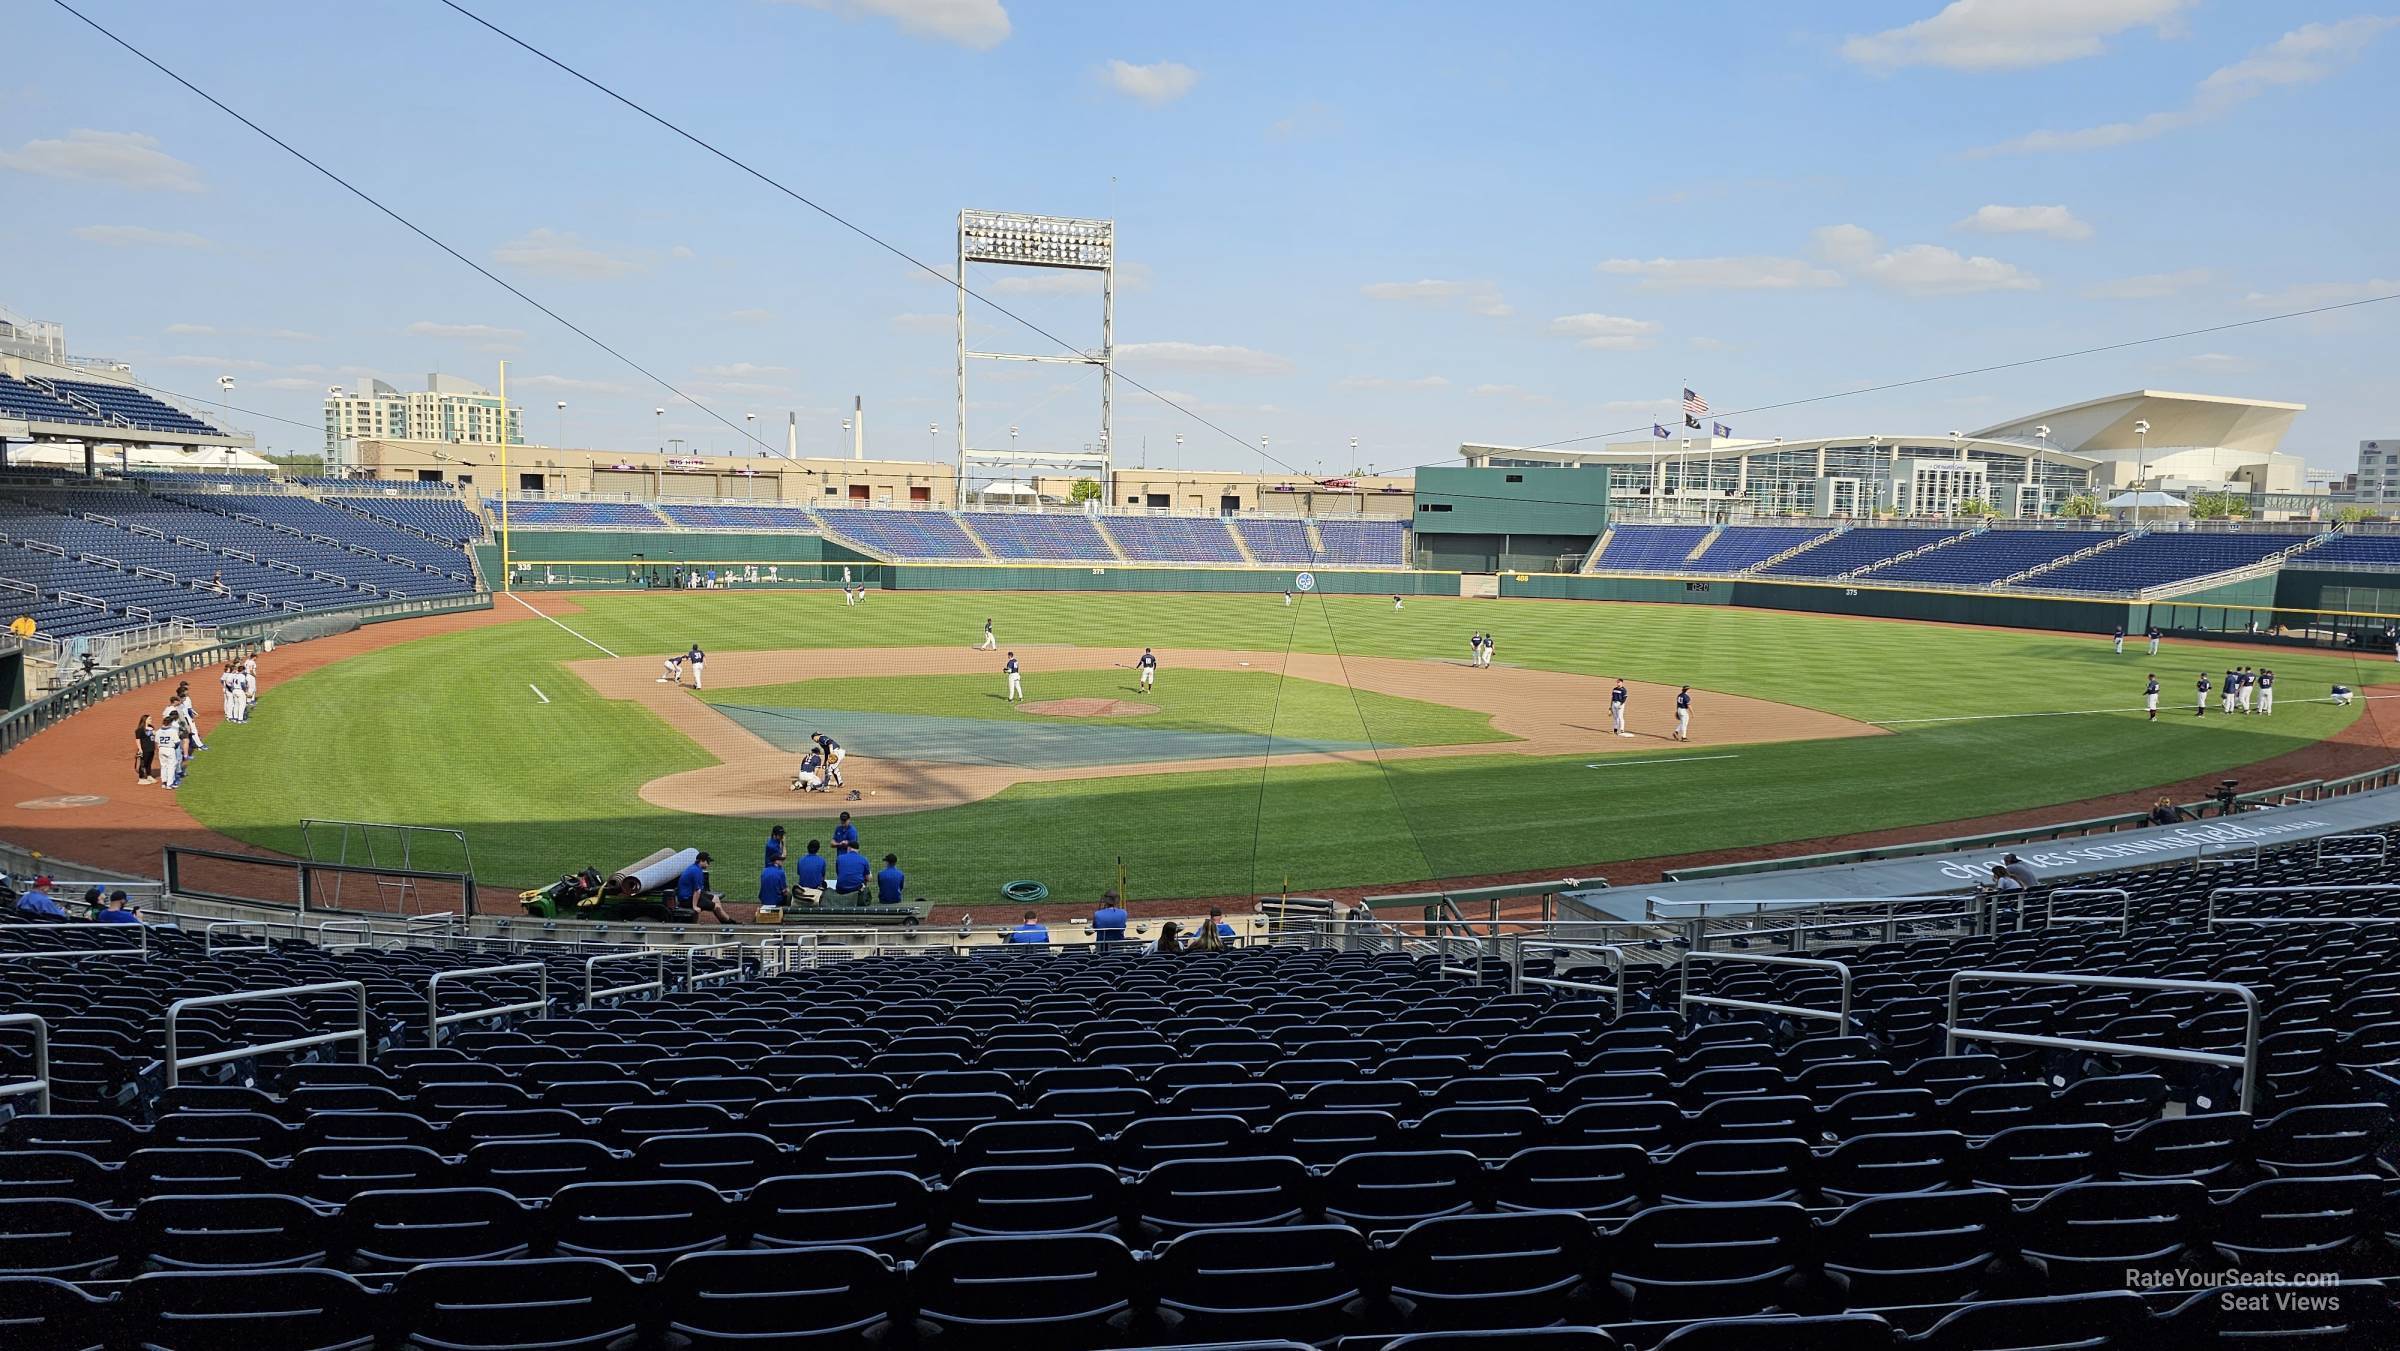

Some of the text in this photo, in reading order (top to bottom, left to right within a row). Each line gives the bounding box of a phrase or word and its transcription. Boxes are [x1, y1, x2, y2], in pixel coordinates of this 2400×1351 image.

[517, 563, 532, 571] 335
[1845, 588, 1858, 596] 375
[159, 736, 171, 745] 22
[2067, 836, 2200, 861] SCHWAB
[2264, 820, 2332, 834] OMAHA
